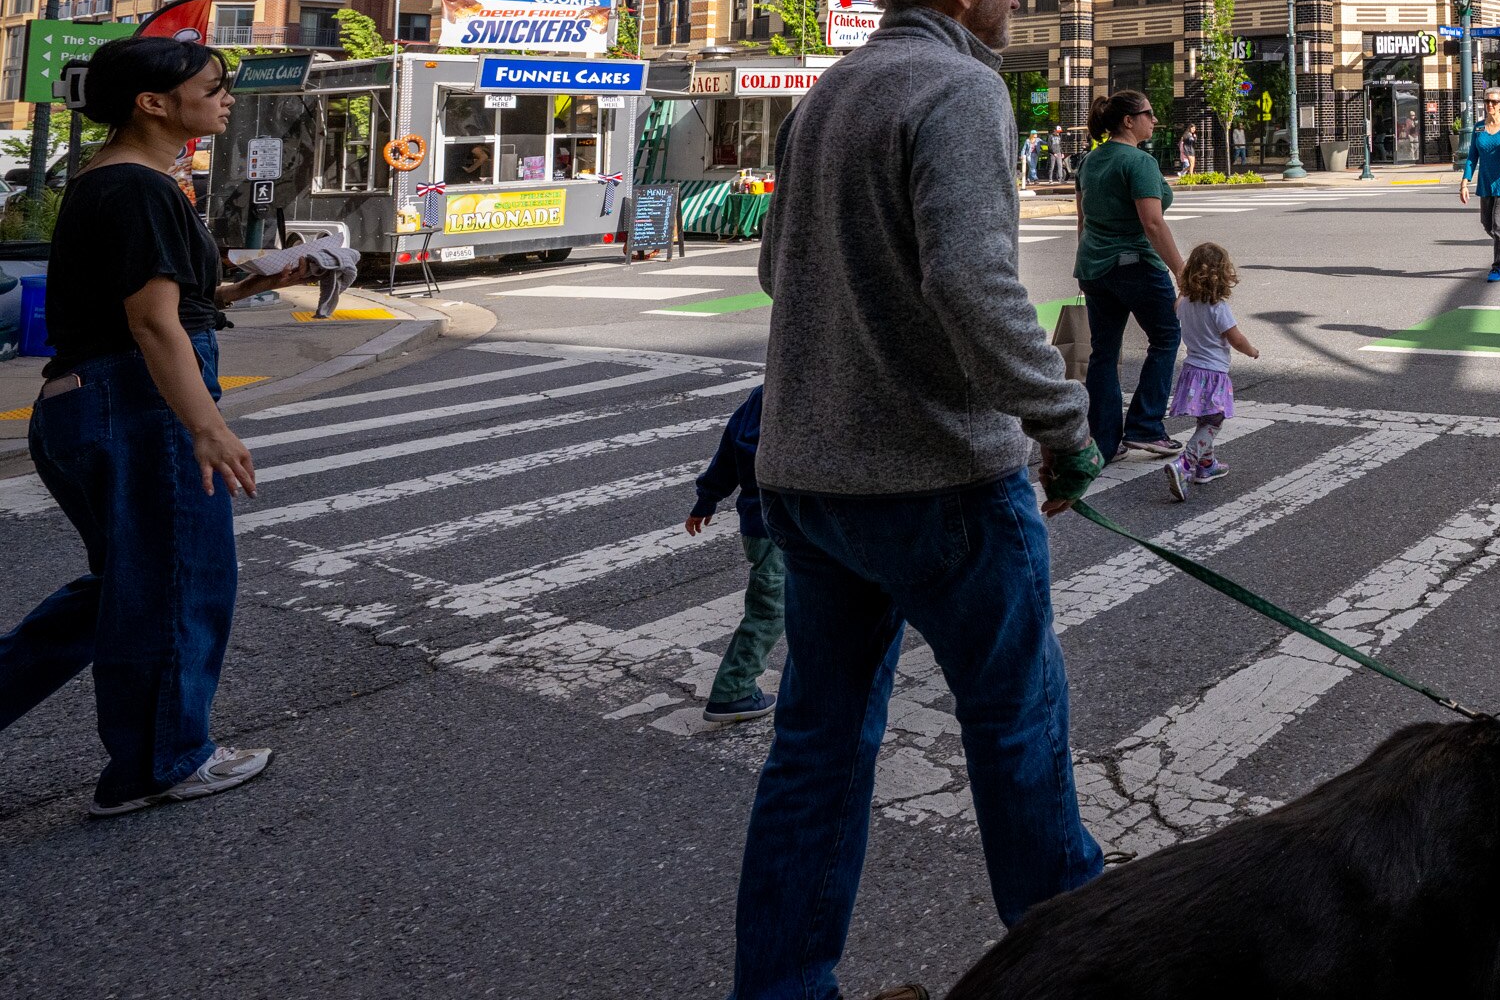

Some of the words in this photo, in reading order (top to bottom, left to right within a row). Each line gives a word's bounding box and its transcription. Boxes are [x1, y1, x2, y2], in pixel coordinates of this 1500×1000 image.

[479, 9, 526, 17] DEEP
[528, 9, 577, 18] FRIED
[834, 14, 875, 28] Chicken
[461, 19, 591, 44] SNICKERS
[62, 35, 84, 45] The
[60, 52, 92, 62] Parki
[242, 66, 275, 81] FUNNEL
[276, 65, 304, 80] CAKES
[495, 66, 571, 83] FUNNEL
[575, 69, 630, 85] CAKES
[741, 74, 780, 88] COLD
[520, 192, 561, 200] FRESH
[646, 188, 666, 196] MENU
[494, 200, 562, 209] SQUEEZED
[448, 207, 561, 234] LEMONADE
